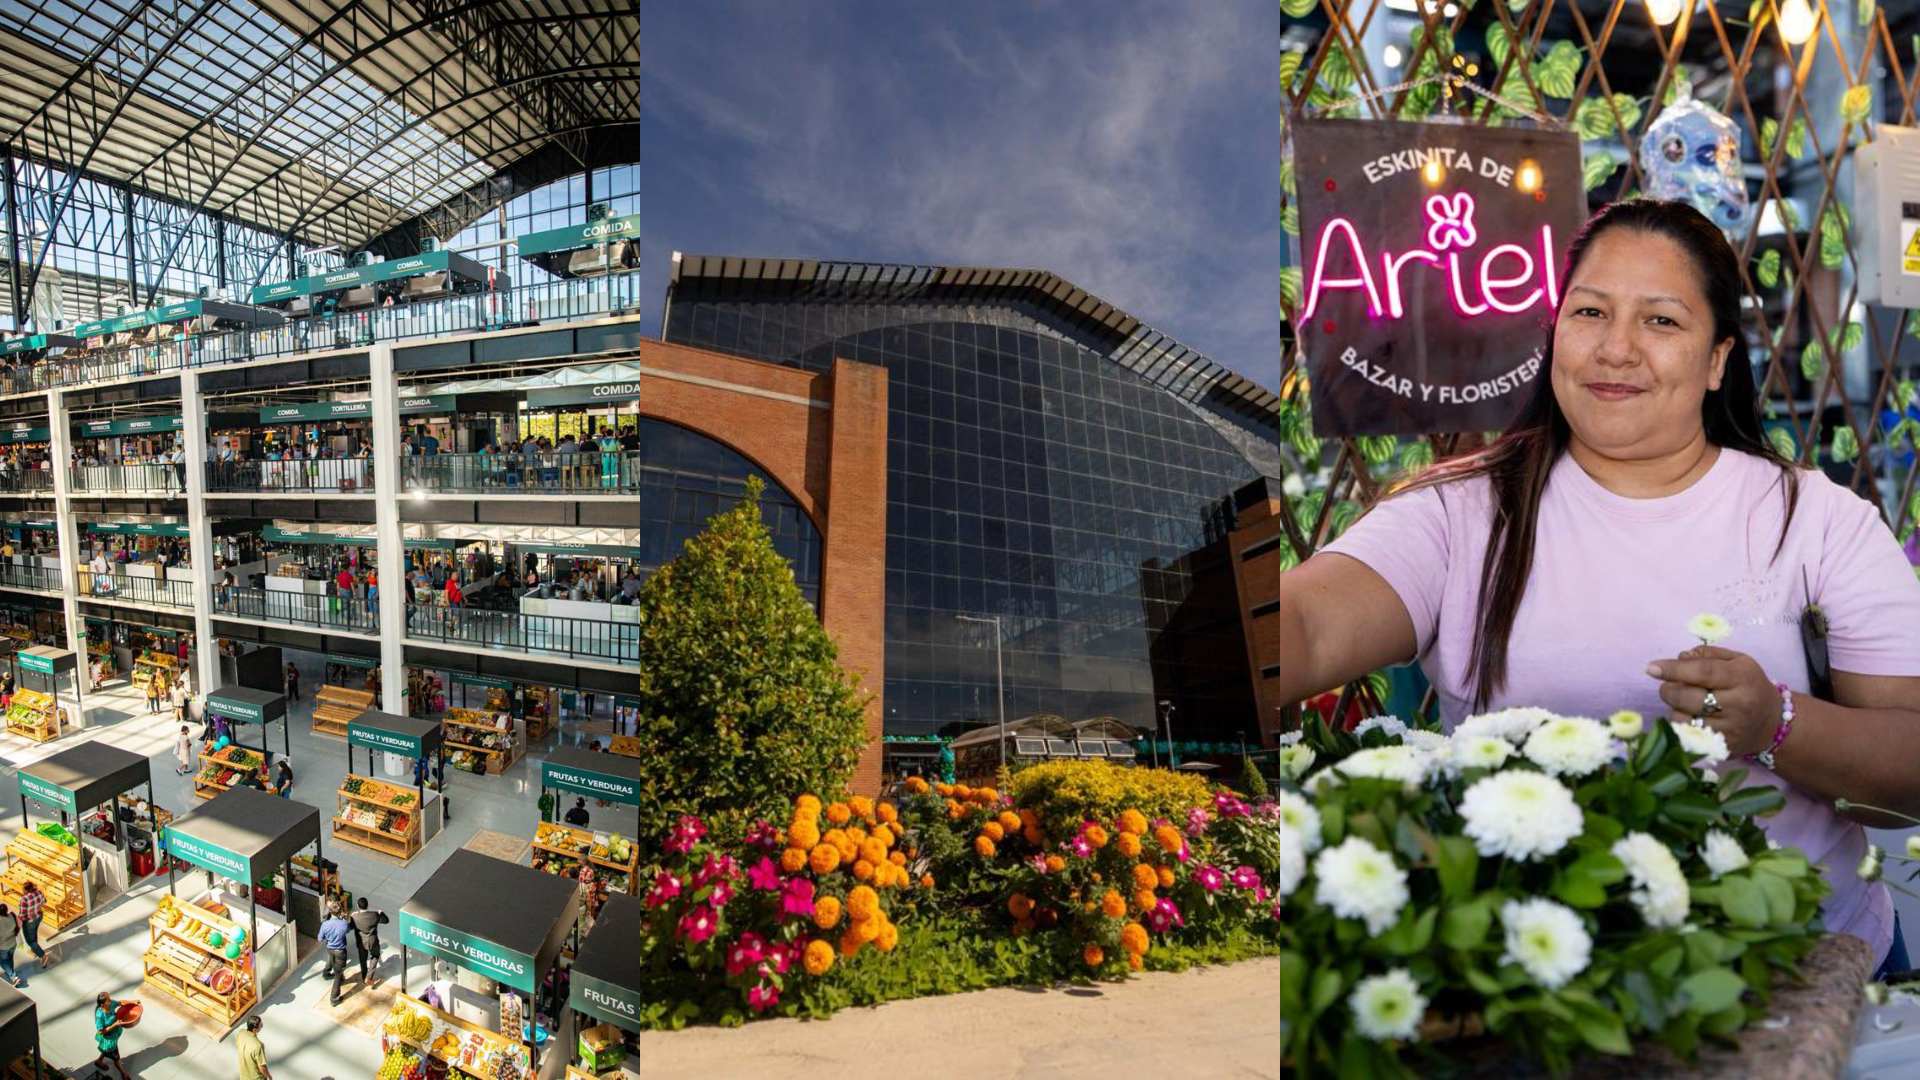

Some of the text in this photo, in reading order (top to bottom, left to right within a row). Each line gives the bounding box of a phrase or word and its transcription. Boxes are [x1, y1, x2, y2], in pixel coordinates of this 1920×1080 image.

[1362, 147, 1514, 187] ESKINITA DE
[583, 221, 632, 237] COMIDA
[396, 260, 424, 270] COMIDA
[1301, 218, 1558, 318] Ariel
[1340, 347, 1413, 398] BAZAR
[1420, 384, 1435, 402] Y
[593, 384, 640, 396] COMIDA
[277, 408, 300, 417] COMIDA
[404, 399, 432, 407] COMIDA
[352, 730, 375, 740] FRUTAS
[381, 736, 415, 749] VERDURAS
[548, 770, 633, 795] FRUTAS Y VERDURAS
[173, 837, 244, 872] FRUTAS Y VERDURAS
[410, 926, 524, 975] FRUTAS Y VERDURAS
[584, 987, 635, 1015] FRUTAS
